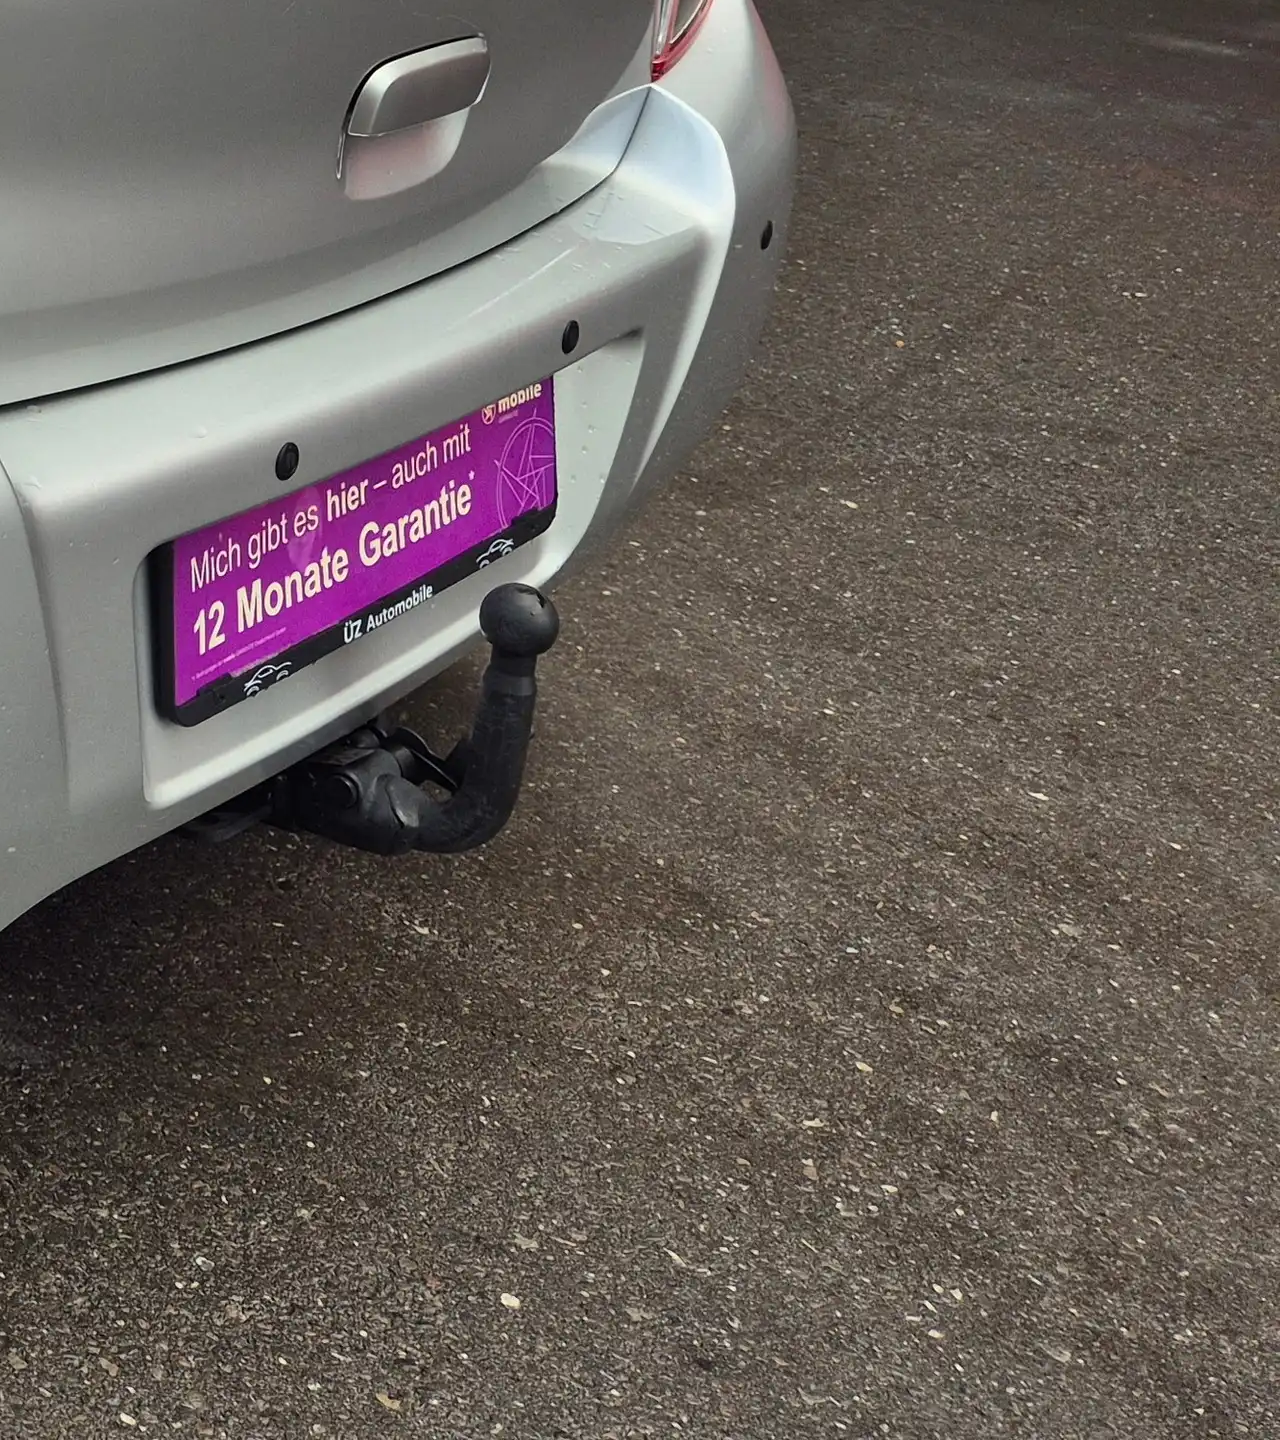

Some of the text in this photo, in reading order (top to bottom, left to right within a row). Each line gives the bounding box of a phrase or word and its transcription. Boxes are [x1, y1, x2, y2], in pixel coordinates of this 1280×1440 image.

[189, 544, 242, 594] Mich
[247, 518, 290, 571] gibt
[292, 505, 320, 538] es
[325, 478, 369, 524] hier
[391, 445, 438, 490] auch
[442, 423, 473, 463] mit
[192, 600, 227, 656] 12
[235, 544, 350, 634] Monate
[343, 583, 434, 645] ÜZ Automobile
